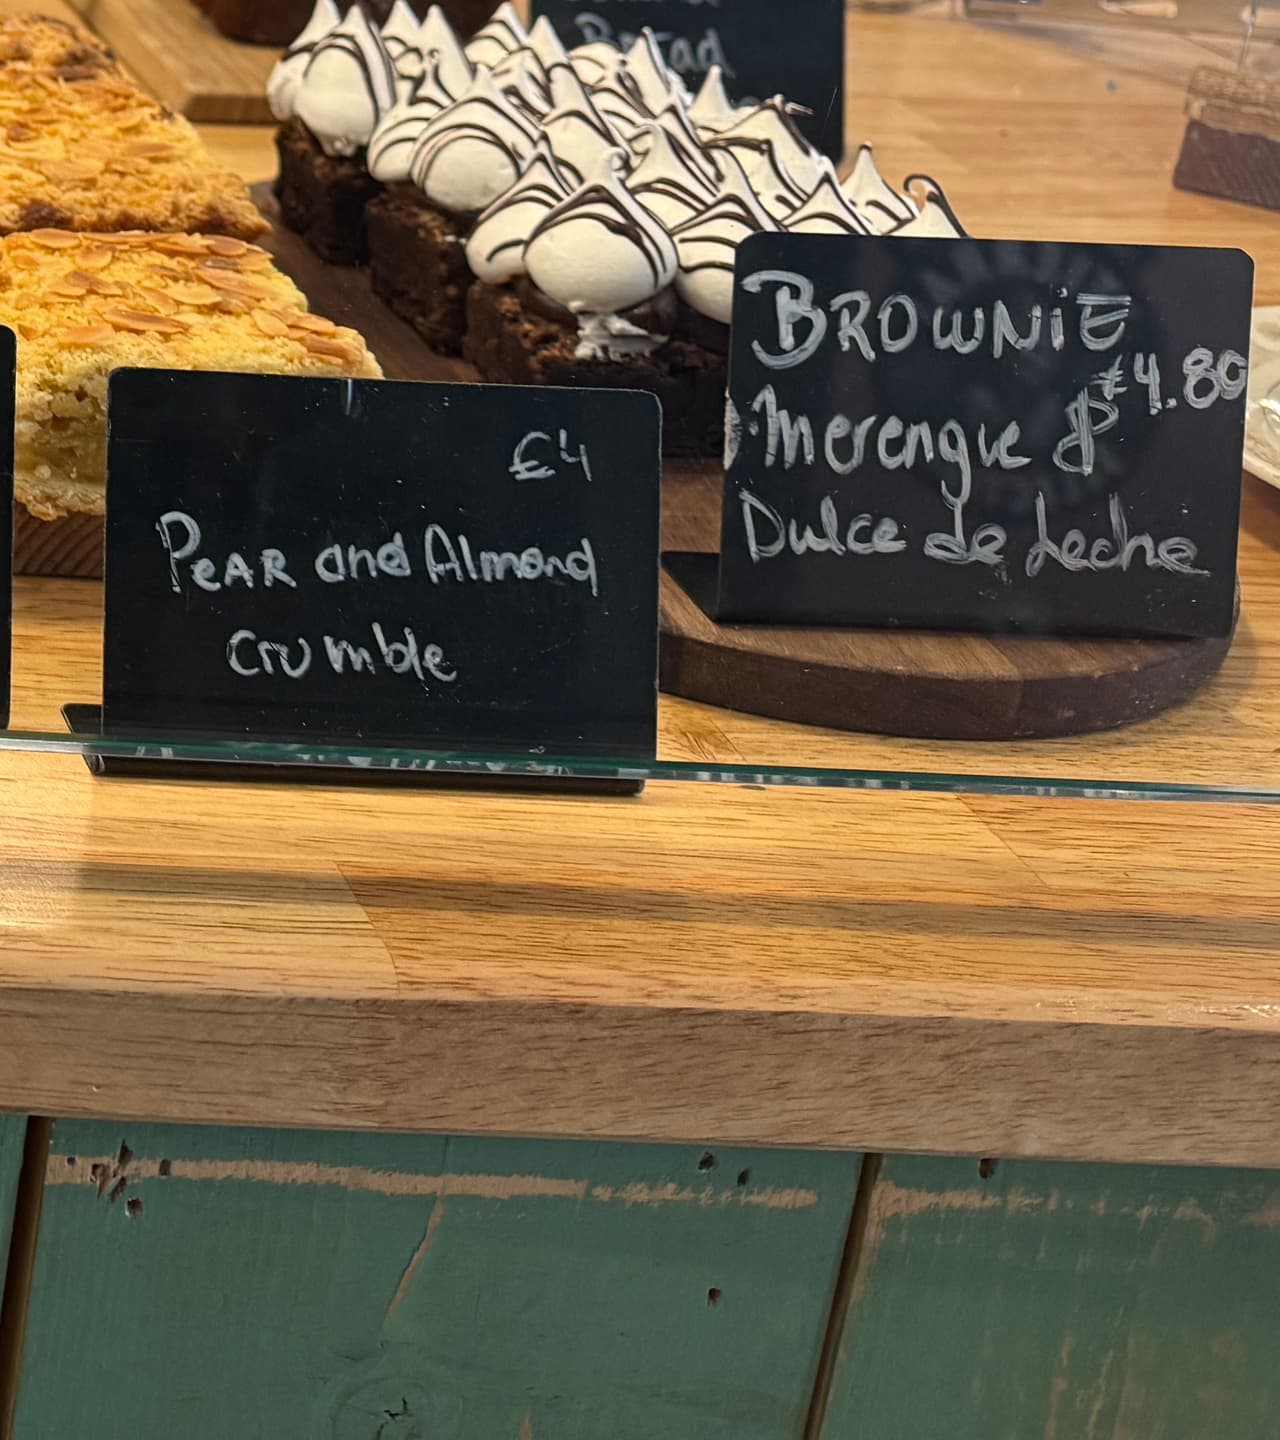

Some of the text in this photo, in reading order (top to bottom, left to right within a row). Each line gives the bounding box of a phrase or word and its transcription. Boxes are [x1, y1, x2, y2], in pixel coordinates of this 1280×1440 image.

[509, 429, 592, 482] €4
[315, 531, 411, 584] and
[425, 523, 598, 596] Almond
[740, 488, 907, 564] Dulce
